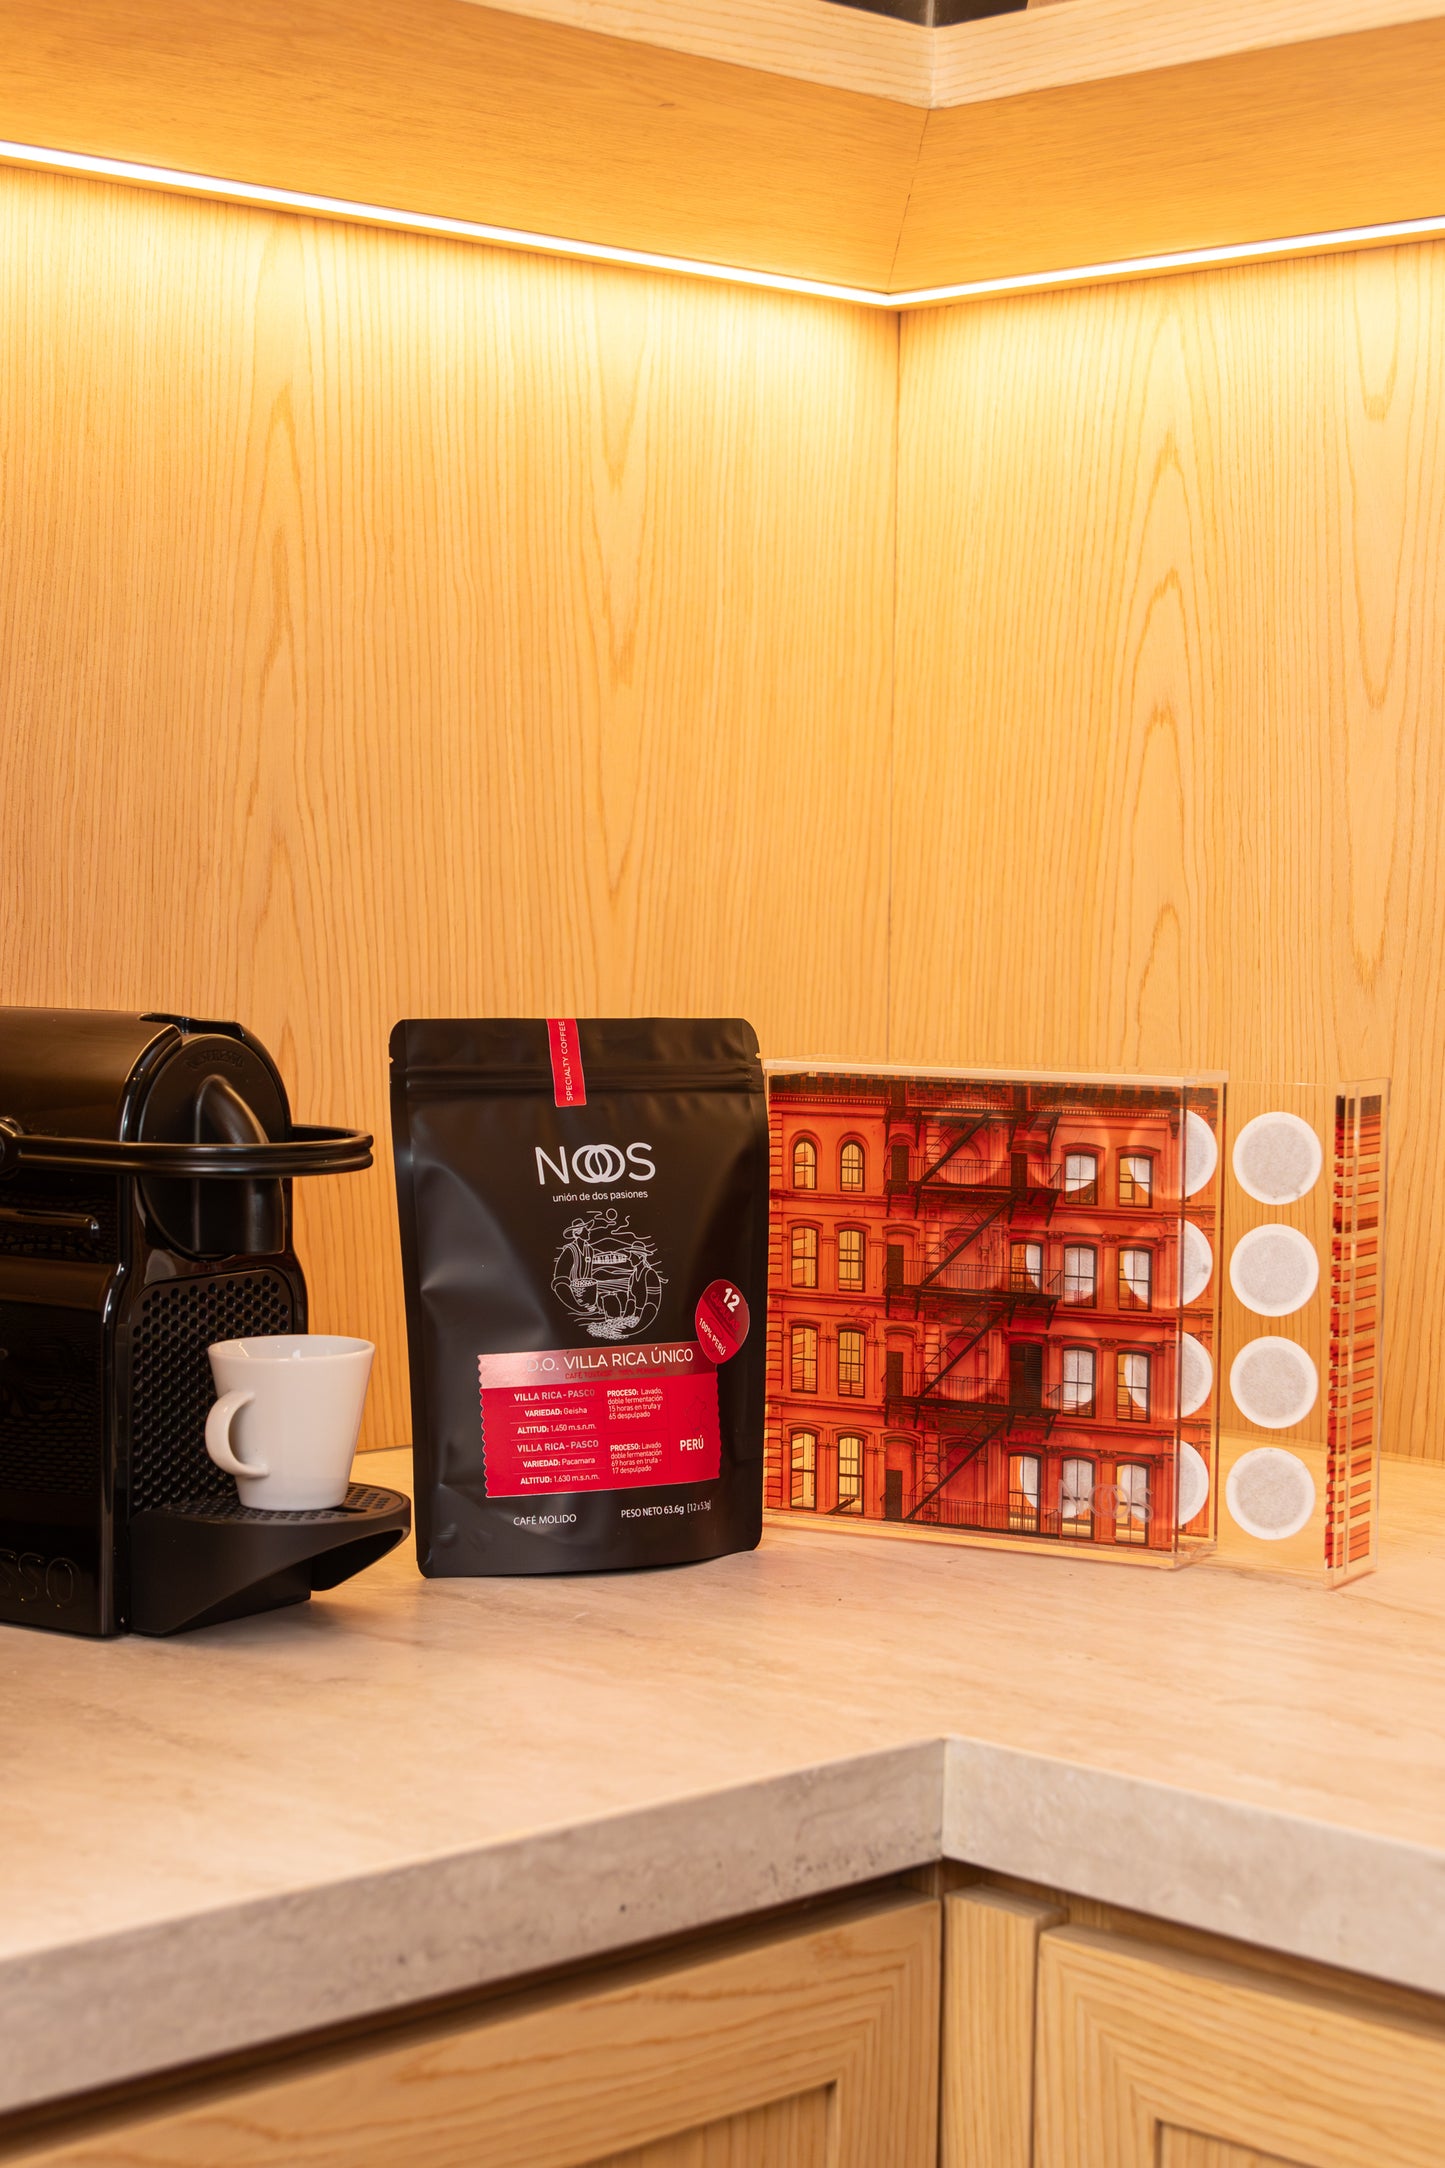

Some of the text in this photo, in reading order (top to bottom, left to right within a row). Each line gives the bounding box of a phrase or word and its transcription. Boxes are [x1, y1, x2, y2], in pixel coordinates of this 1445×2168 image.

[558, 1020, 574, 1102] SPECIALTY COFFEE
[535, 1142, 656, 1185] NOOS
[552, 1190, 649, 1203] unión de dos pasiones
[723, 1287, 741, 1313] 12
[699, 1317, 727, 1356] 100% PERÚ
[526, 1346, 694, 1372] D.O. VILLA RICA ÚNICO
[514, 1392, 540, 1402] VILLA
[606, 1388, 639, 1397] PROCESO:
[524, 1406, 588, 1417] VARIEDAD: Geisha
[608, 1404, 616, 1413] 15
[616, 1404, 634, 1412] horas
[608, 1412, 616, 1420] 65
[517, 1425, 550, 1434] ALTITUD:
[516, 1443, 543, 1453] VILLA
[609, 1441, 662, 1452] PROCESO: Lavado
[679, 1435, 704, 1452] PERÚ
[610, 1451, 626, 1460] doble
[522, 1457, 596, 1468] VARIEDAD: Pacamara
[611, 1459, 619, 1467] 69
[619, 1458, 635, 1467] horas
[611, 1464, 652, 1475] 17 despulpado
[520, 1473, 600, 1485] ALTITUD: 1.630 m.s.n.m.
[620, 1508, 641, 1518] PESO
[642, 1506, 663, 1516] NETO
[663, 1504, 685, 1515] 63.6g
[513, 1513, 577, 1526] CAFÉ MOLIDO
